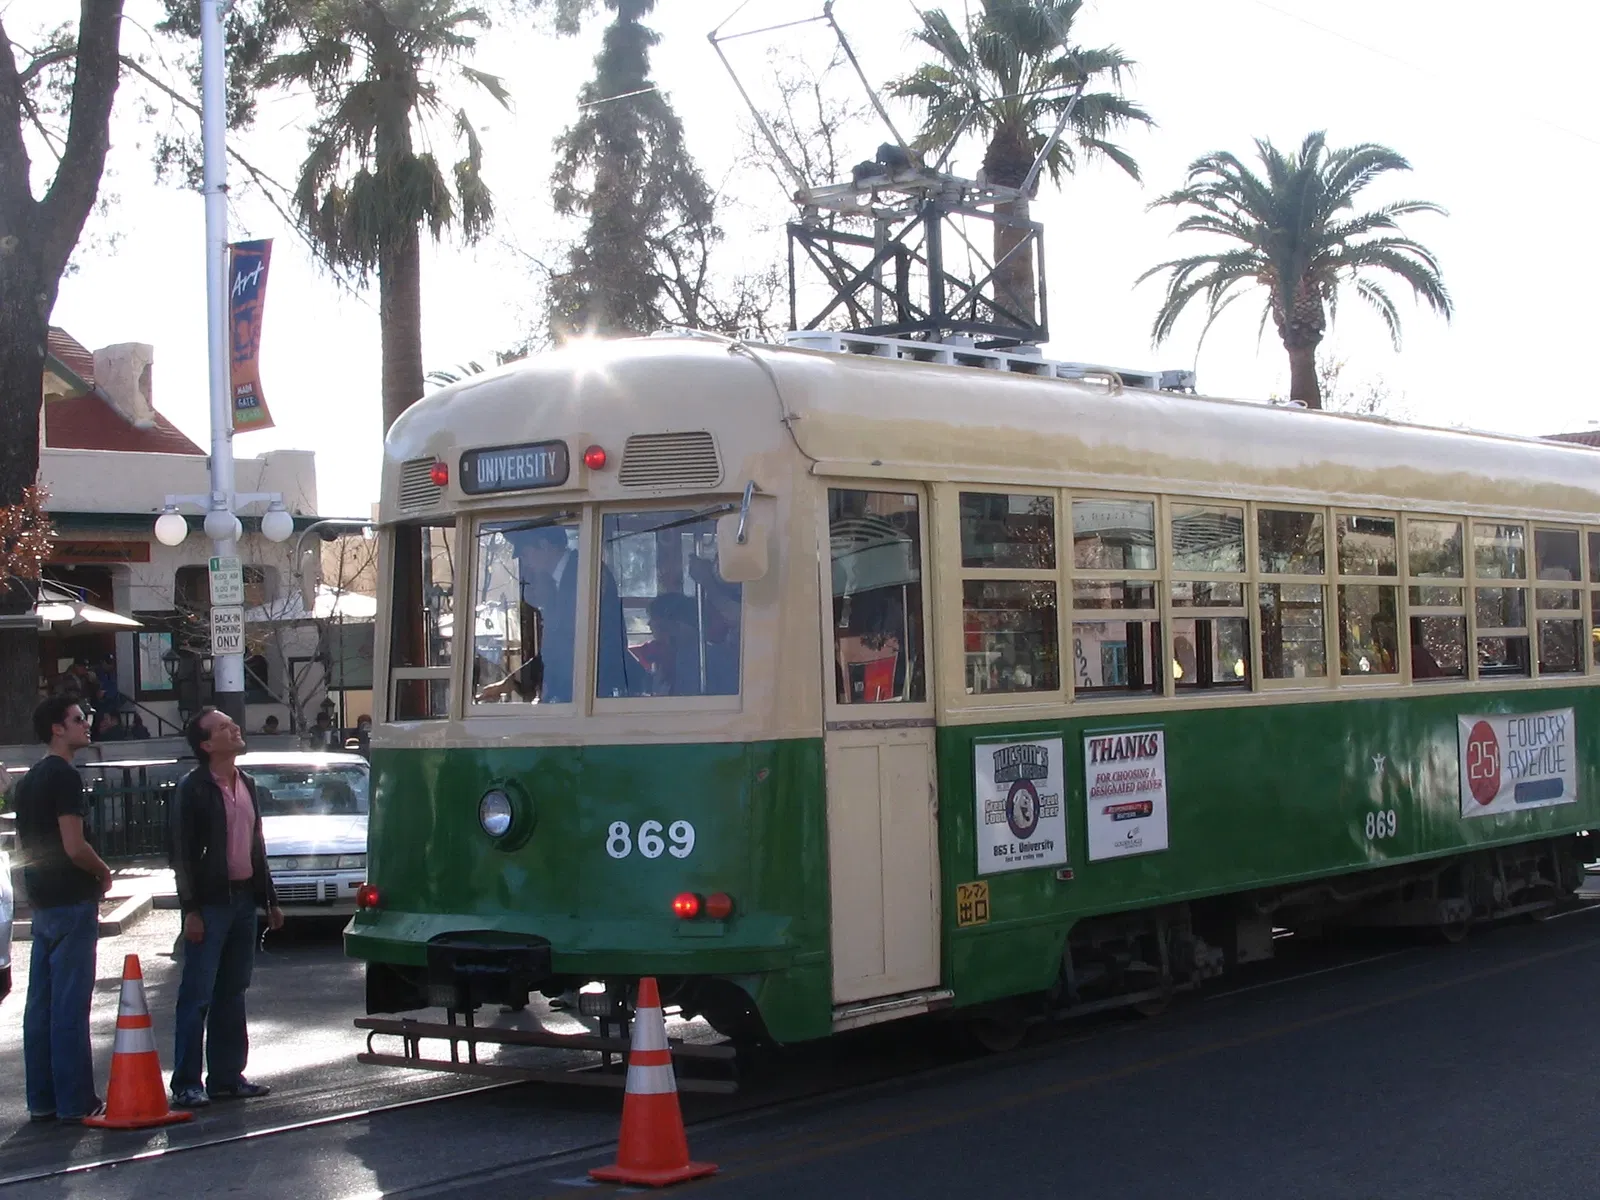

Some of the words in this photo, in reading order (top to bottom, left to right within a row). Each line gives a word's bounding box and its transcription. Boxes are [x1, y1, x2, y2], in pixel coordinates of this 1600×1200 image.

[231, 261, 264, 299] Art
[238, 396, 257, 408] GATE
[477, 452, 556, 483] UNIVERSITY
[214, 614, 240, 624] BACK-IN
[215, 625, 241, 635] PARKING
[217, 635, 240, 648] ONLY
[1090, 733, 1159, 763] THANKS
[1507, 745, 1566, 779] AVENUE
[1096, 773, 1111, 784] FOR
[1112, 768, 1150, 782] CHOOSING
[1150, 768, 1157, 777] A
[1090, 782, 1136, 798] DESIGNATED
[1136, 779, 1162, 792] DRIVER
[985, 799, 1007, 813] Great
[1039, 793, 1059, 807] Great
[985, 812, 1007, 825] Food
[1040, 806, 1060, 819] Beer
[1366, 809, 1396, 840] 869
[606, 820, 695, 859] 869
[994, 844, 1008, 857] 865
[1010, 843, 1017, 854] E.
[1019, 839, 1054, 854] University
[960, 900, 988, 924] 出口
